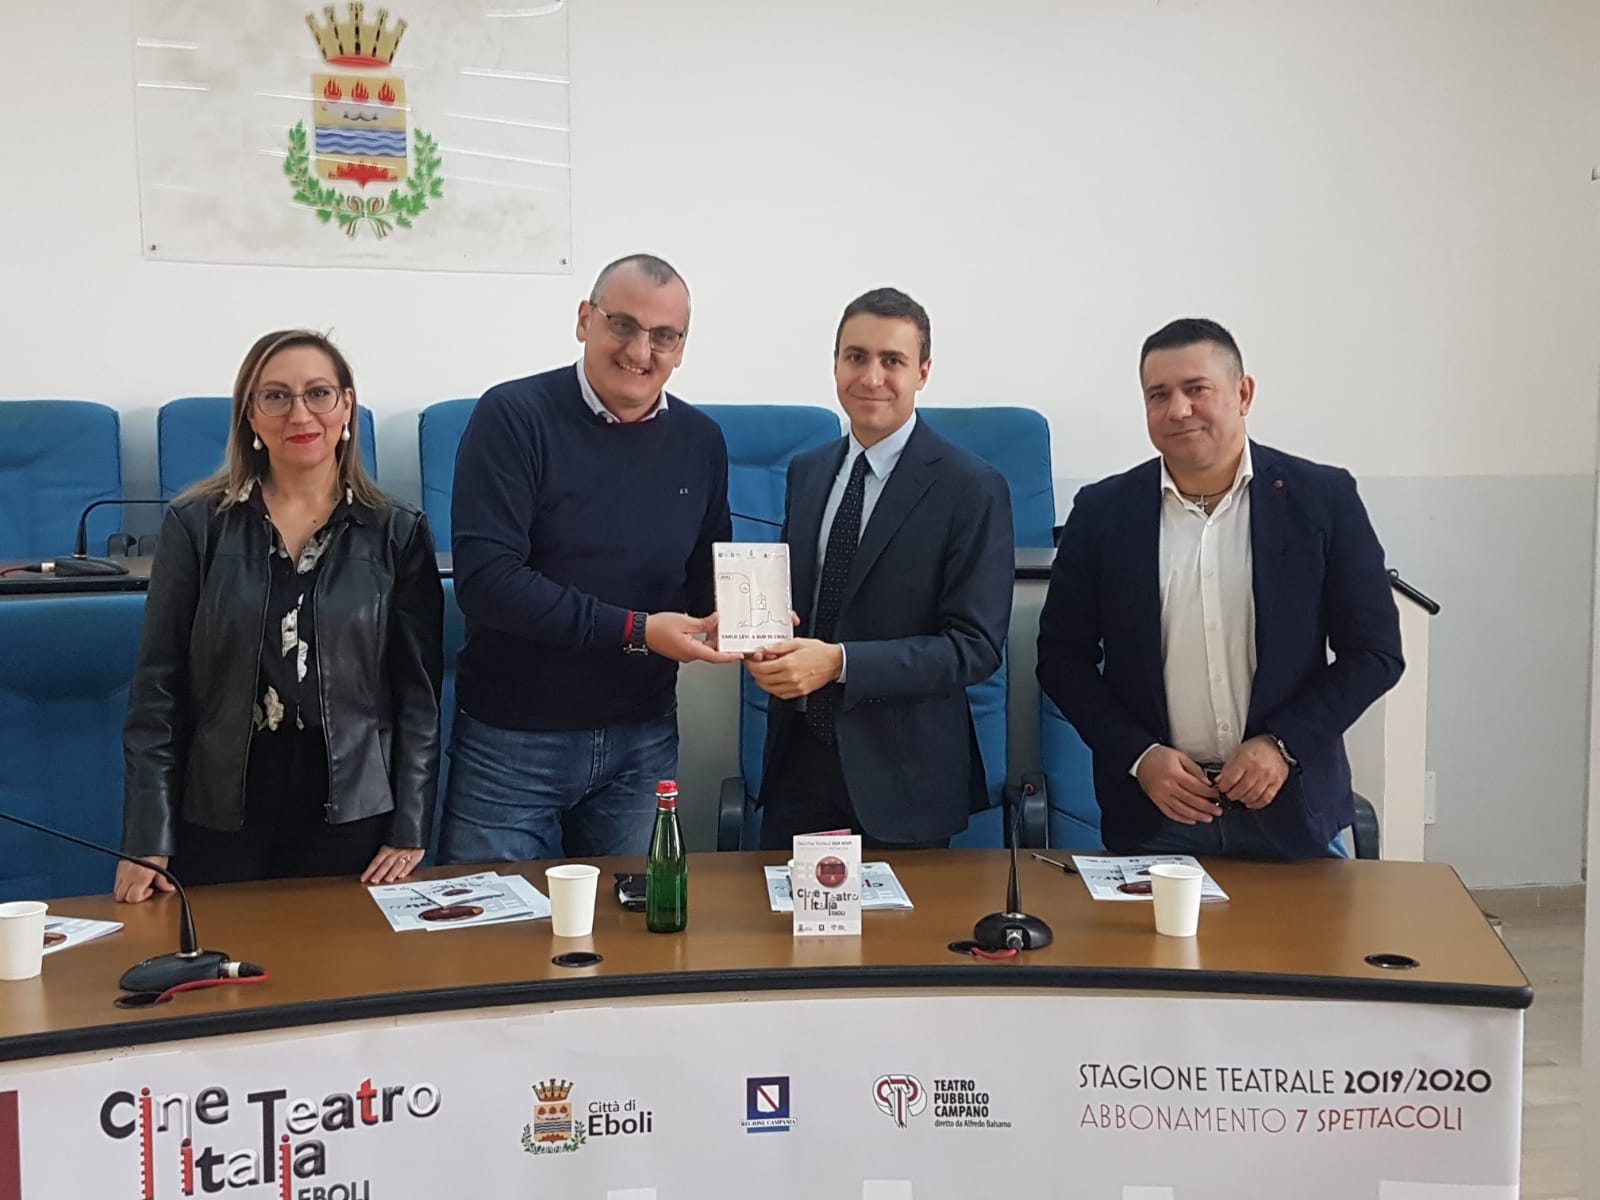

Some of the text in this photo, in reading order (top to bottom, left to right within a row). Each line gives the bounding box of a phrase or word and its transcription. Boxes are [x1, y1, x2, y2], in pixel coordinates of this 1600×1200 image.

[933, 1079, 976, 1092] TEATRO
[1079, 1063, 1493, 1095] STAGIONE TEATRALE 2019/2020
[933, 1092, 990, 1105] PUBBLICO
[588, 1098, 637, 1115] Città di
[933, 1105, 990, 1118] CAMPANO
[587, 1111, 653, 1138] Eboli
[934, 1119, 955, 1128] diretto
[955, 1119, 963, 1128] da
[964, 1119, 986, 1128] Alfredo
[1079, 1103, 1463, 1135] ABBONAMENTO 7 SPETTACOLI
